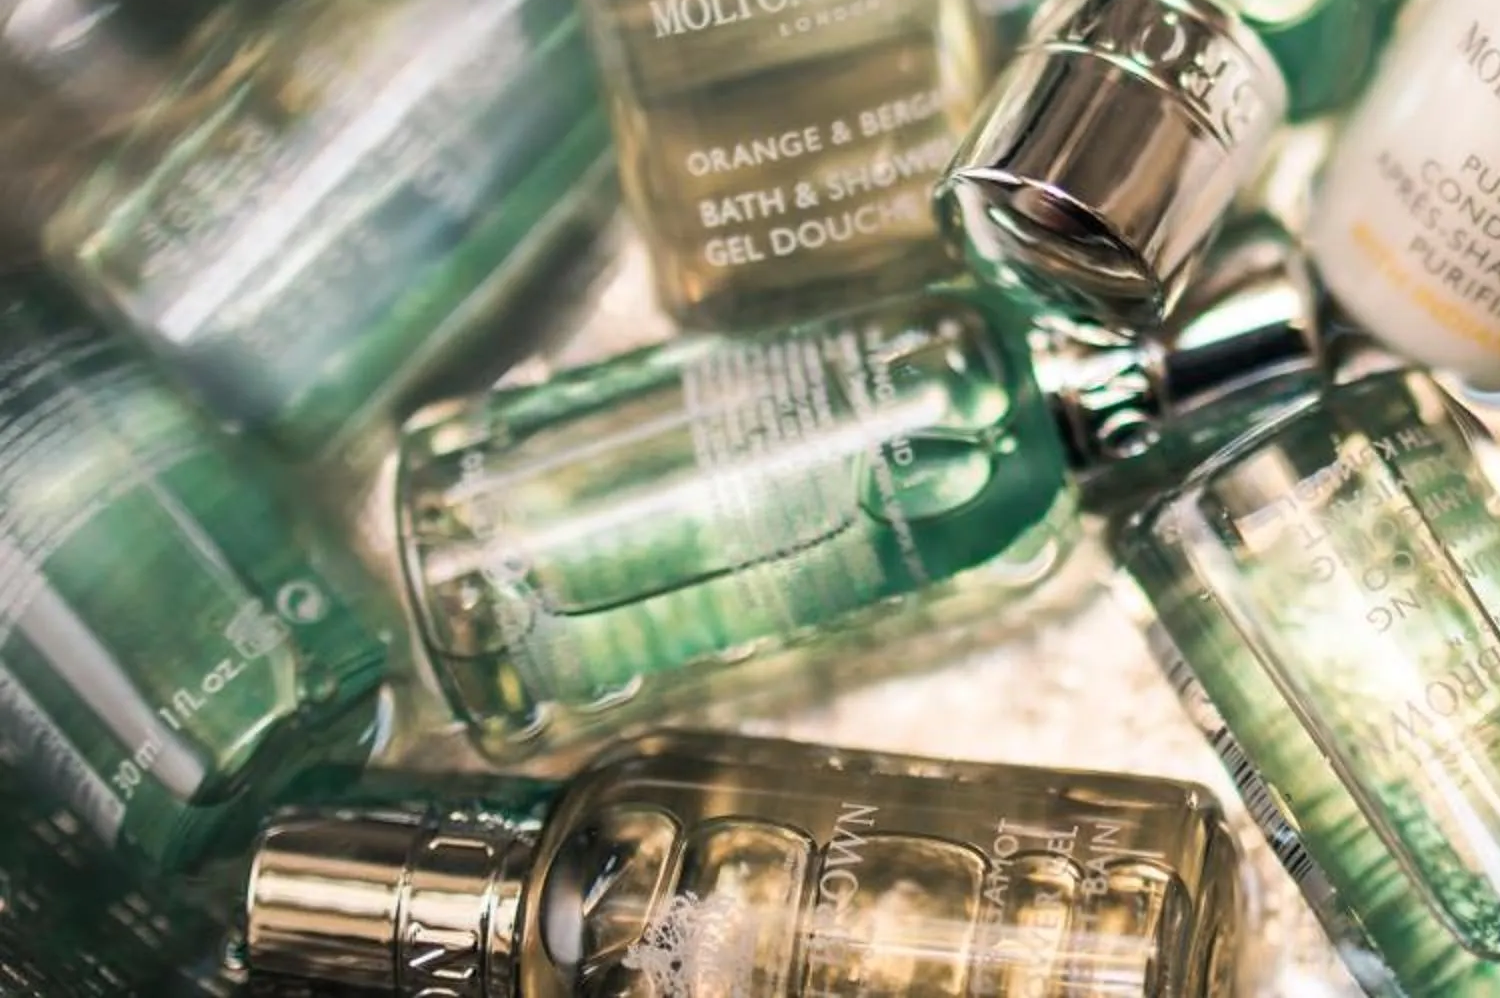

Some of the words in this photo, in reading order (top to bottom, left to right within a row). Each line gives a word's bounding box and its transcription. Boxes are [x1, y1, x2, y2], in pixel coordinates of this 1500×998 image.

[687, 124, 823, 176] ORANGE
[831, 120, 852, 145] &
[699, 189, 785, 228] BATH
[794, 183, 818, 210] &
[704, 236, 765, 269] GEL
[1081, 822, 1122, 895] BAIN
